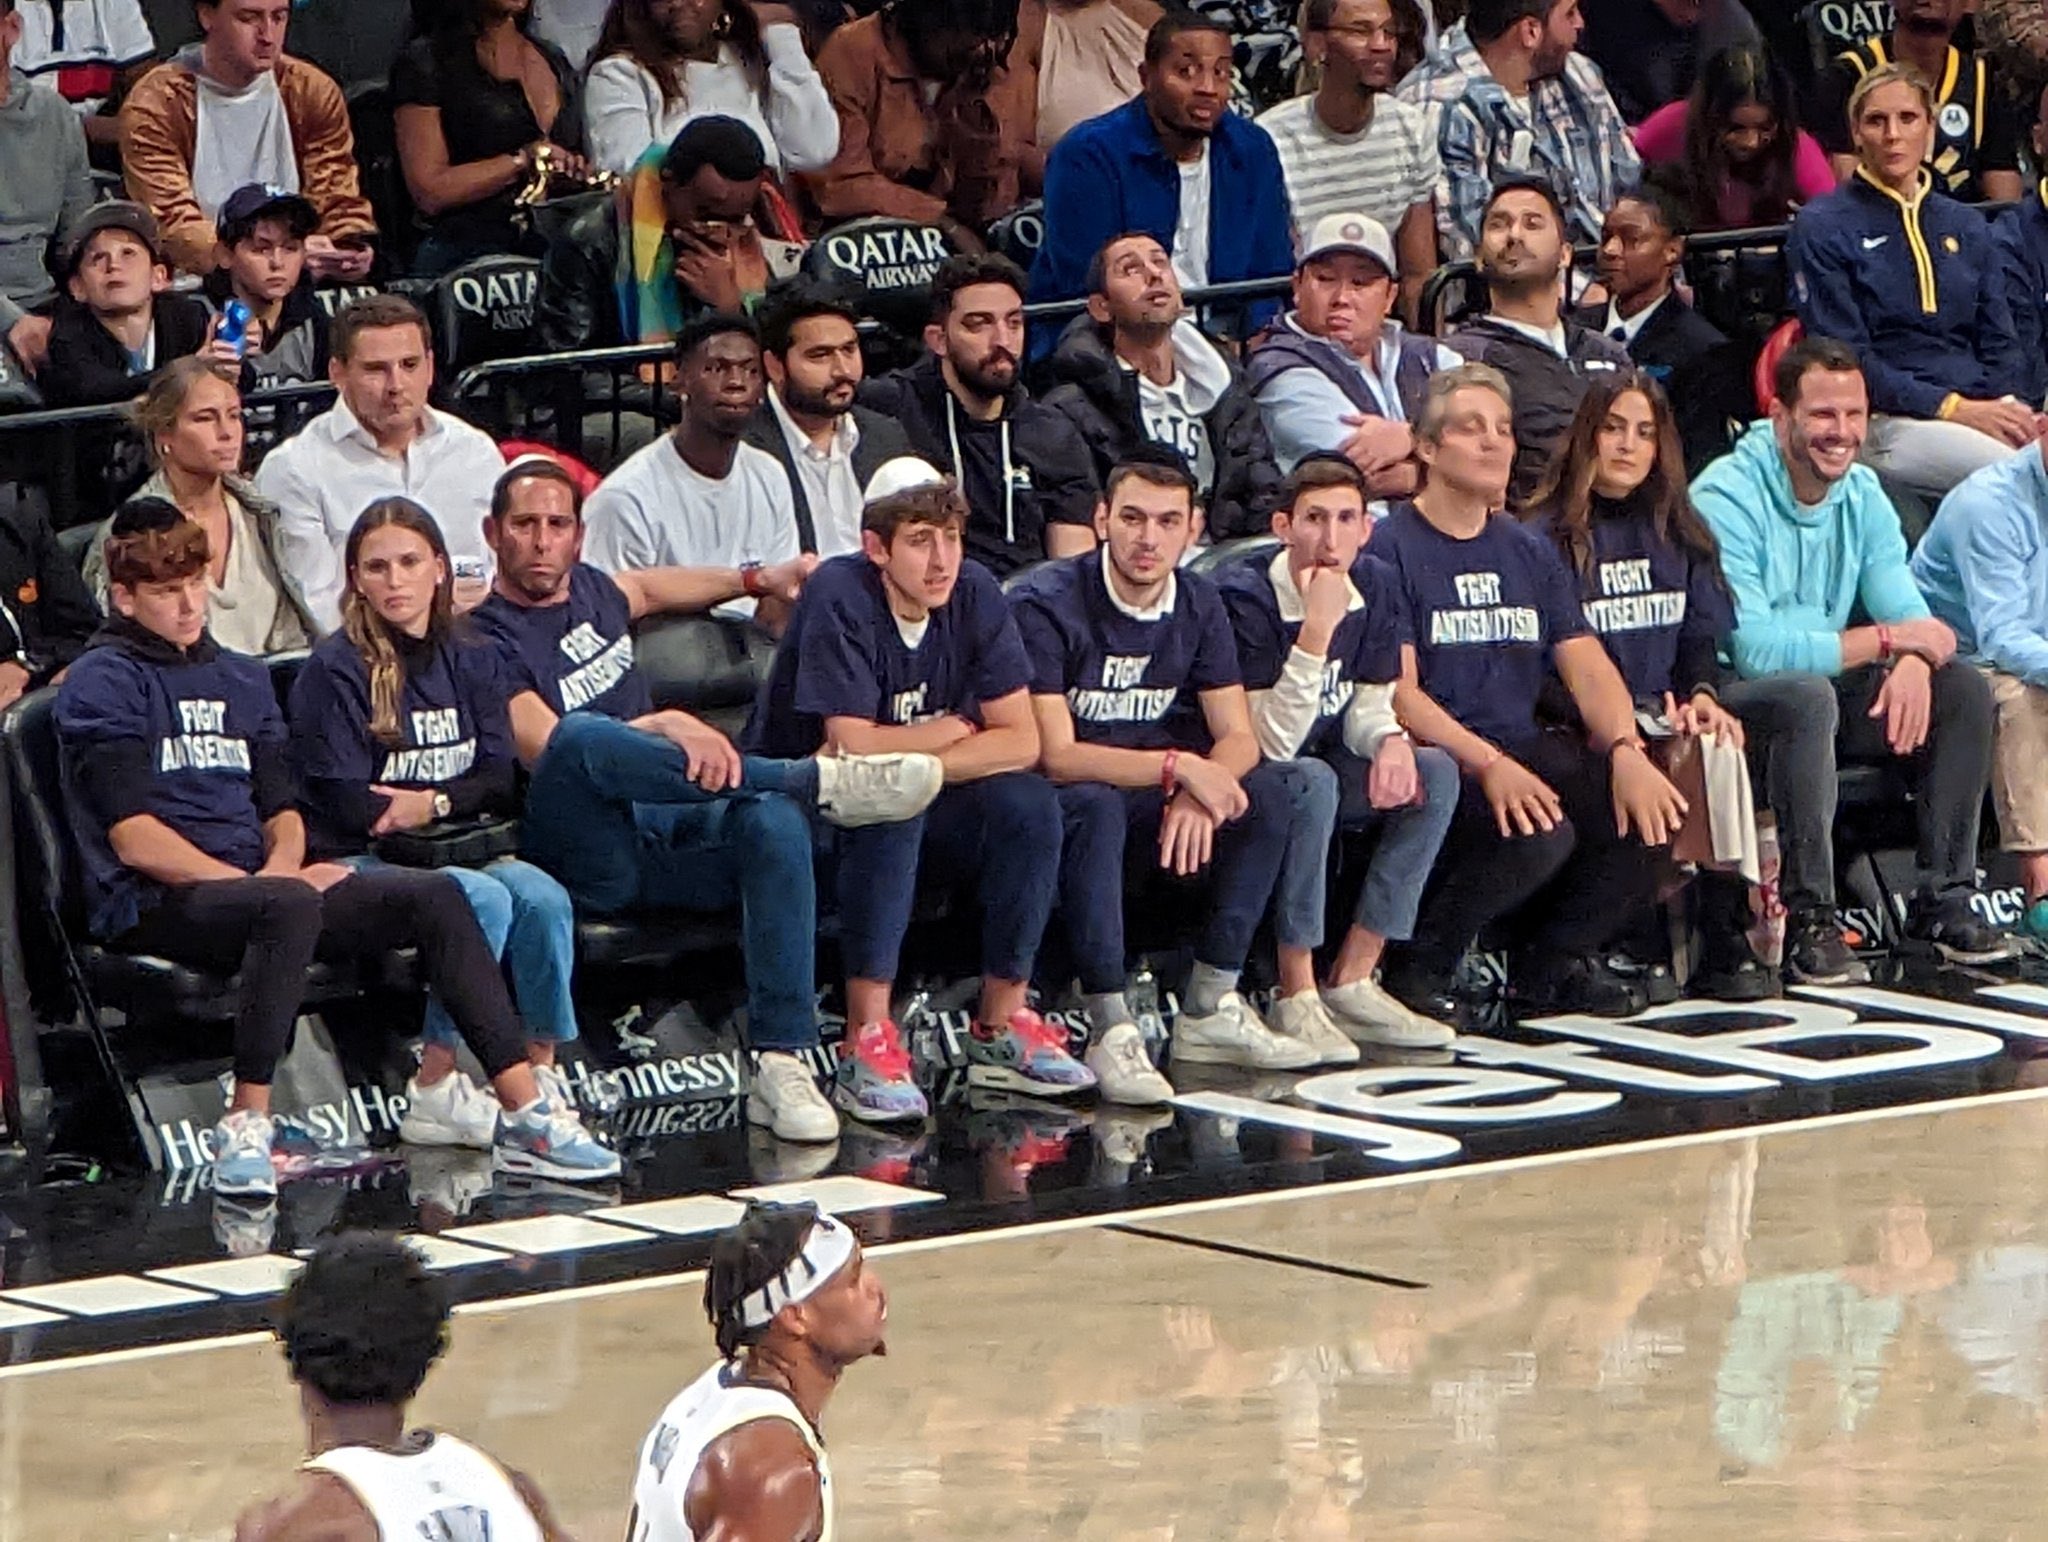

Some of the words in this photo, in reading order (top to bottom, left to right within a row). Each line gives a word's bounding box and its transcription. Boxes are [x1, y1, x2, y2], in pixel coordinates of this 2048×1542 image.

[1820, 3, 1896, 39] QAT
[827, 227, 949, 275] QATAR
[453, 270, 538, 317] QATA
[1599, 558, 1652, 596] FIGHT
[554, 1049, 741, 1107] Hennessy
